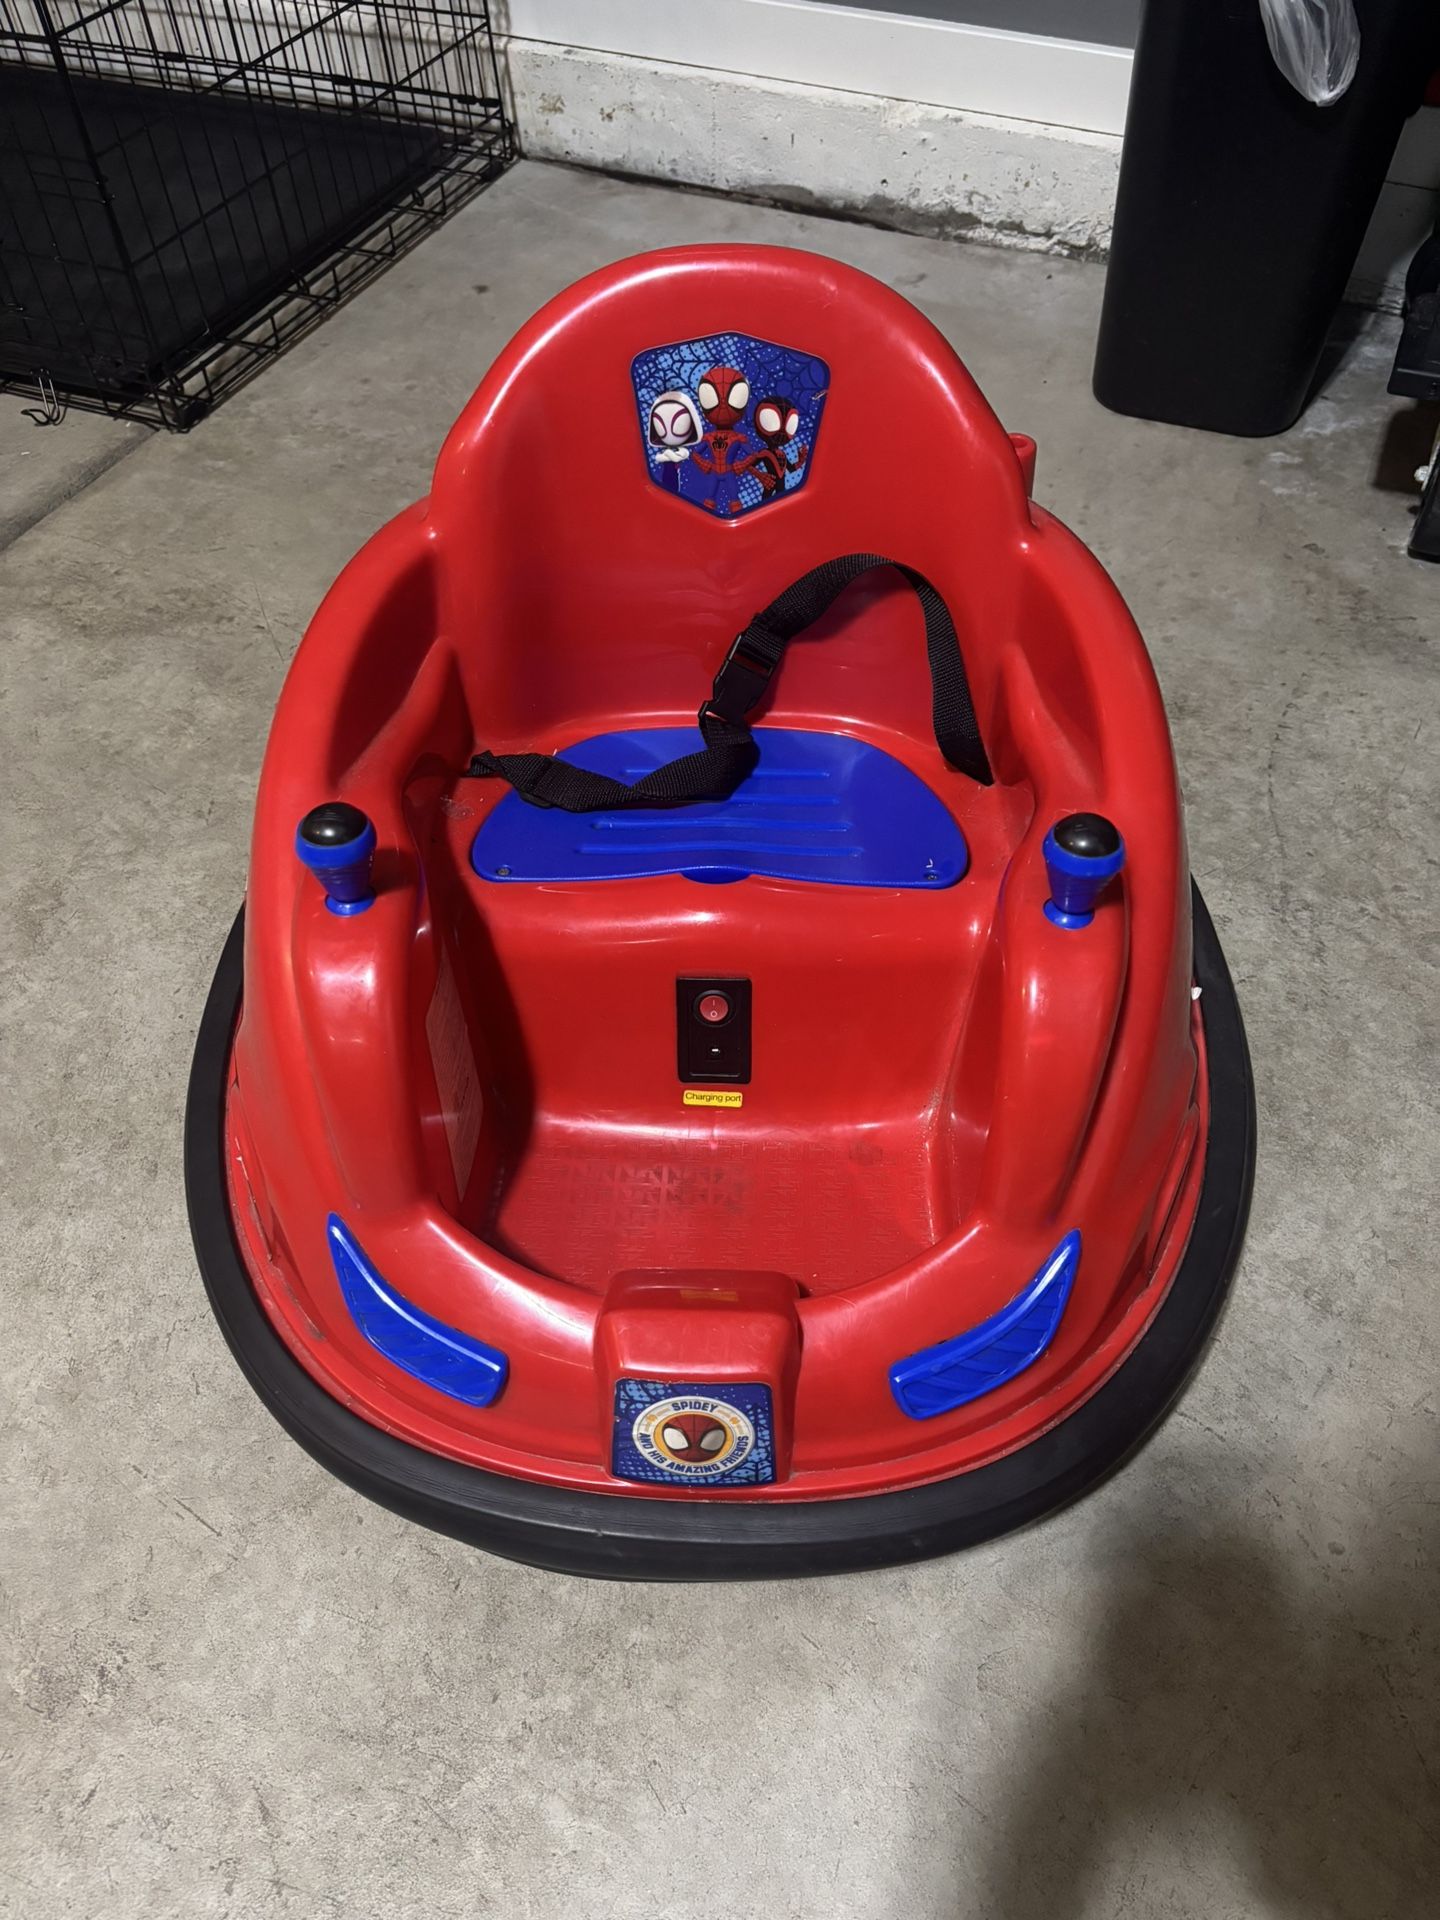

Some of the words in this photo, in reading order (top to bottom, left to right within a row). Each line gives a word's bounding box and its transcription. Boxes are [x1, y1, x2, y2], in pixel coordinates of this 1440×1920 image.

[685, 1092, 723, 1103] Charging
[725, 1094, 741, 1102] port
[671, 1401, 719, 1413] SPIDEY
[638, 1432, 653, 1450] AND
[648, 1450, 668, 1464] HIS
[666, 1463, 720, 1474] AMAZING
[721, 1435, 749, 1468] FRIENDS
